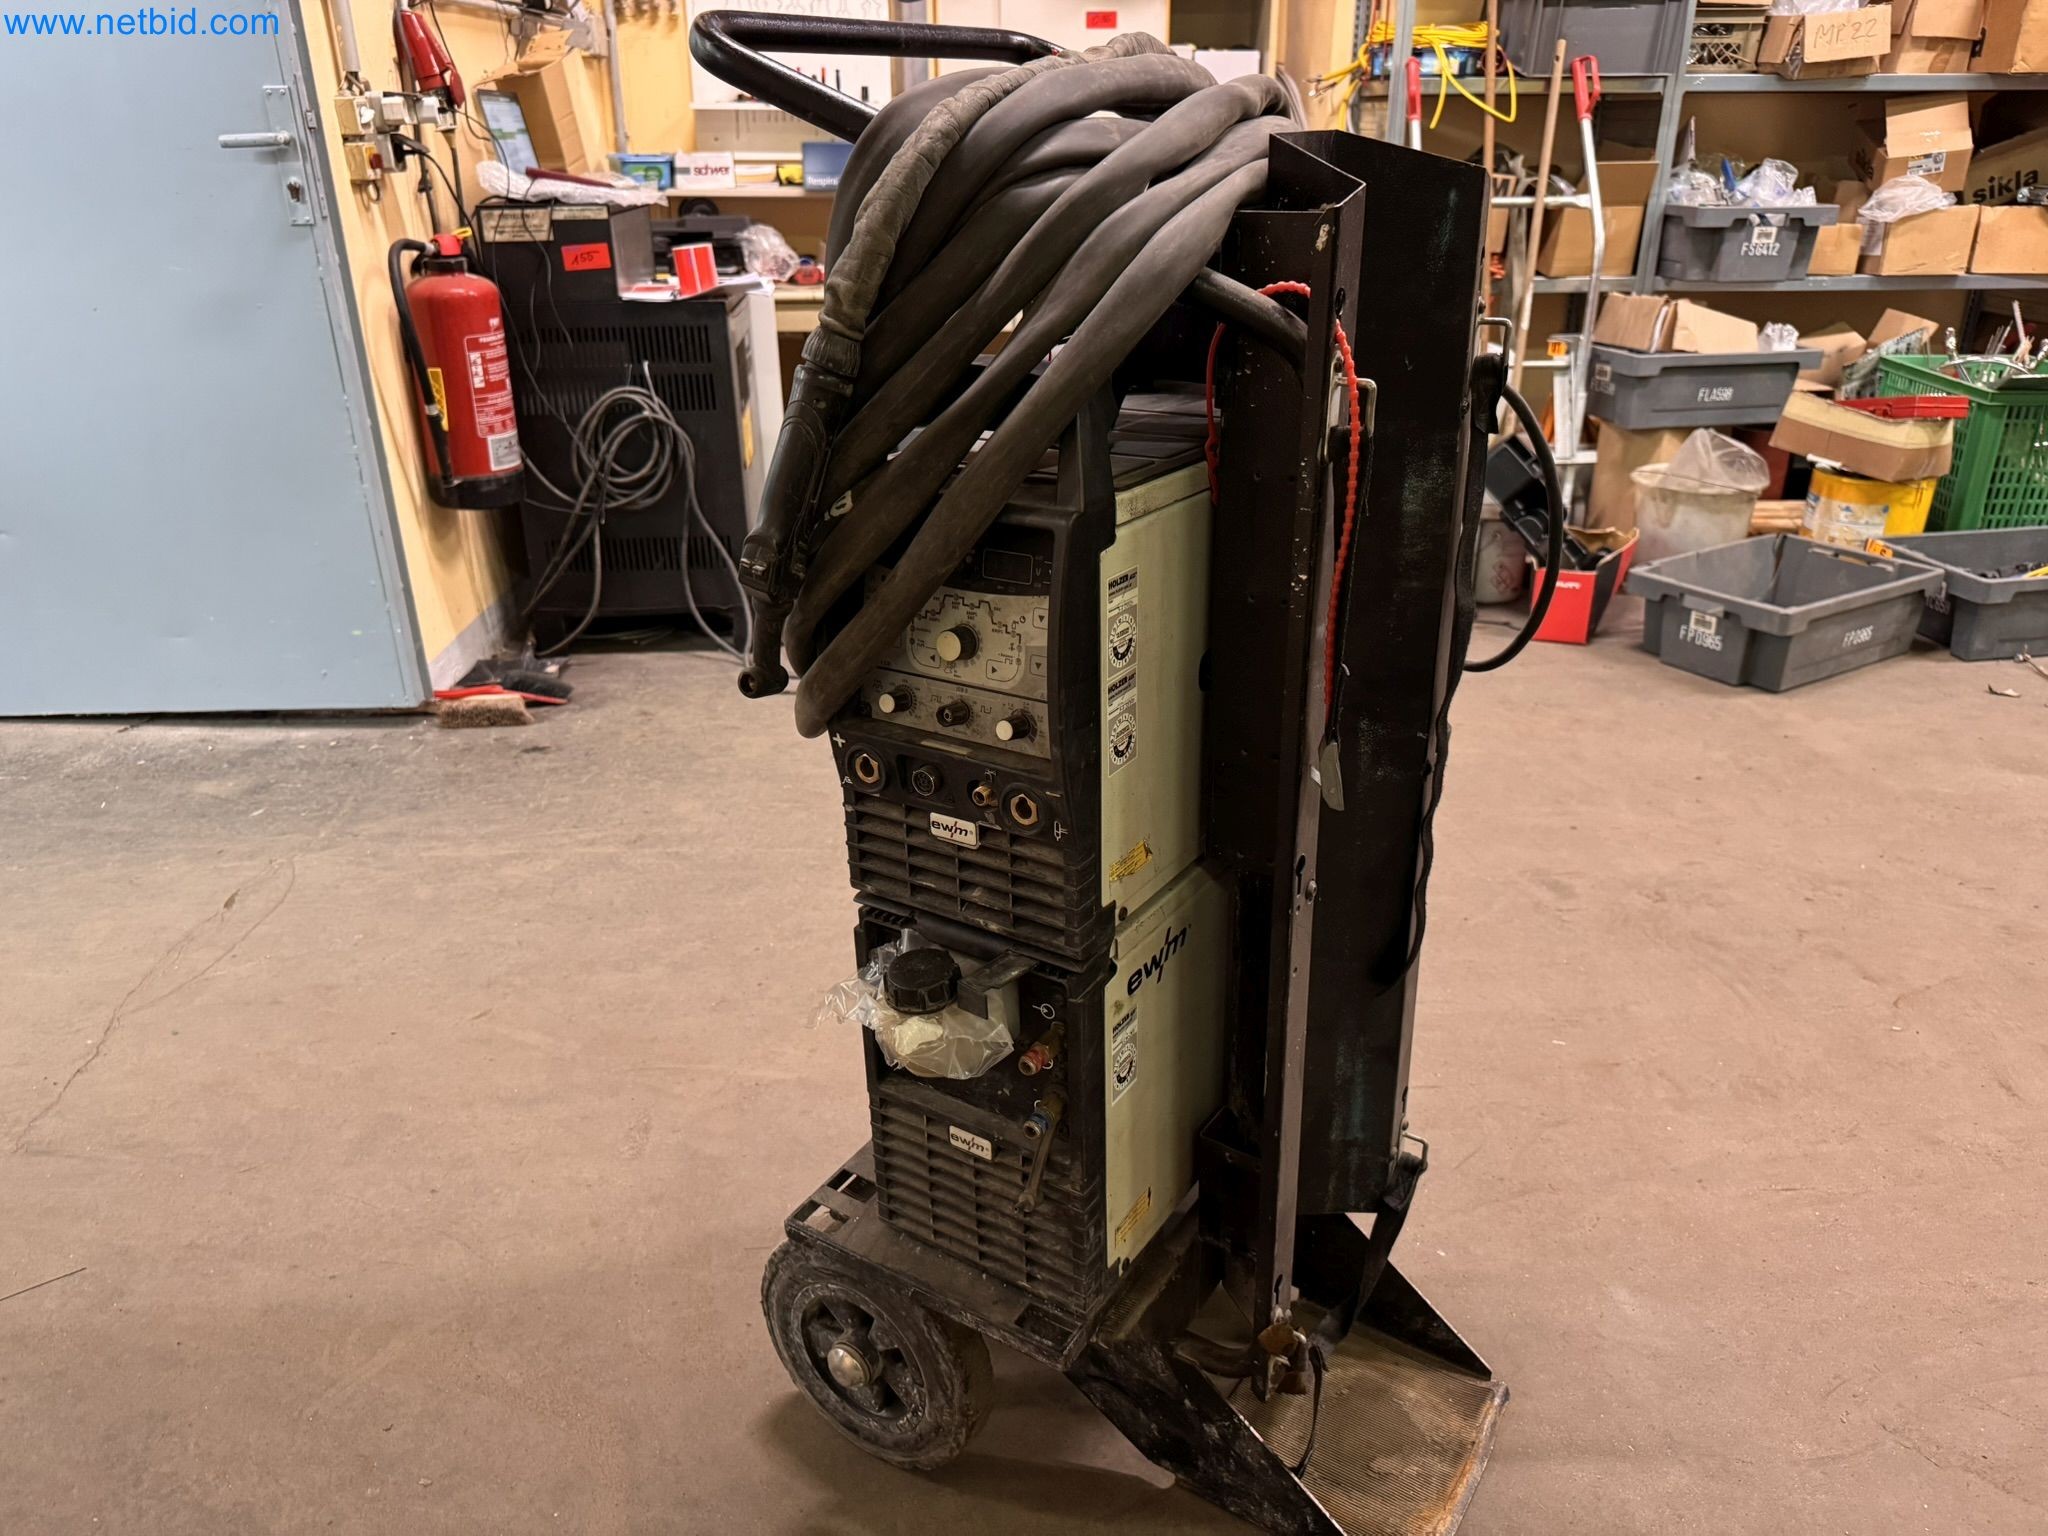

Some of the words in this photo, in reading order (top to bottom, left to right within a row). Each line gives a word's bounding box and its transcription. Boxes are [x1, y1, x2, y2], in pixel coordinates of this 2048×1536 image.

[693, 161, 730, 177] schwer
[1972, 168, 2040, 204] sikla
[1108, 574, 1129, 591] HOLZER
[931, 820, 969, 838] ewm
[1127, 926, 1188, 996] ewm
